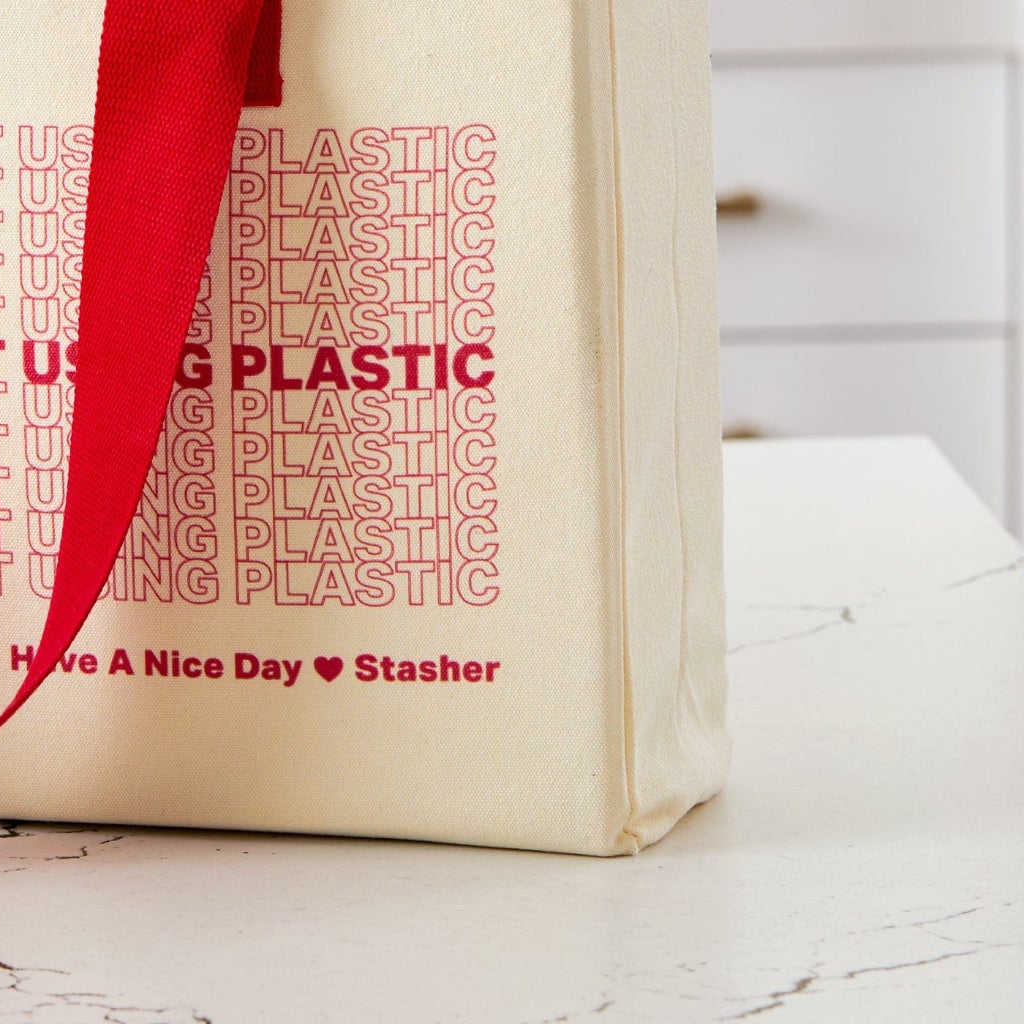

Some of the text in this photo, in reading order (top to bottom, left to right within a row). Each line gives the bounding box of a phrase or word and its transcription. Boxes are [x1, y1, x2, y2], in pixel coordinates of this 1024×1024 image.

[231, 125, 495, 173] PLASTIC
[230, 168, 495, 217] PLASTIC
[230, 211, 495, 260] PLASTIC
[230, 256, 495, 304] PLASTIC
[231, 299, 495, 347] PLASTIC
[231, 342, 495, 391] PLASTIC
[231, 387, 496, 434] PLASTIC
[232, 430, 497, 477] PLASTIC
[27, 469, 215, 517] UNG
[233, 473, 498, 520] PLASTIC
[29, 511, 217, 560] UNG
[235, 516, 499, 563] PLASTIC
[30, 552, 219, 604] UING
[236, 559, 500, 606] PLASTIC
[10, 644, 500, 687] Hve A Nice Day Stasher
